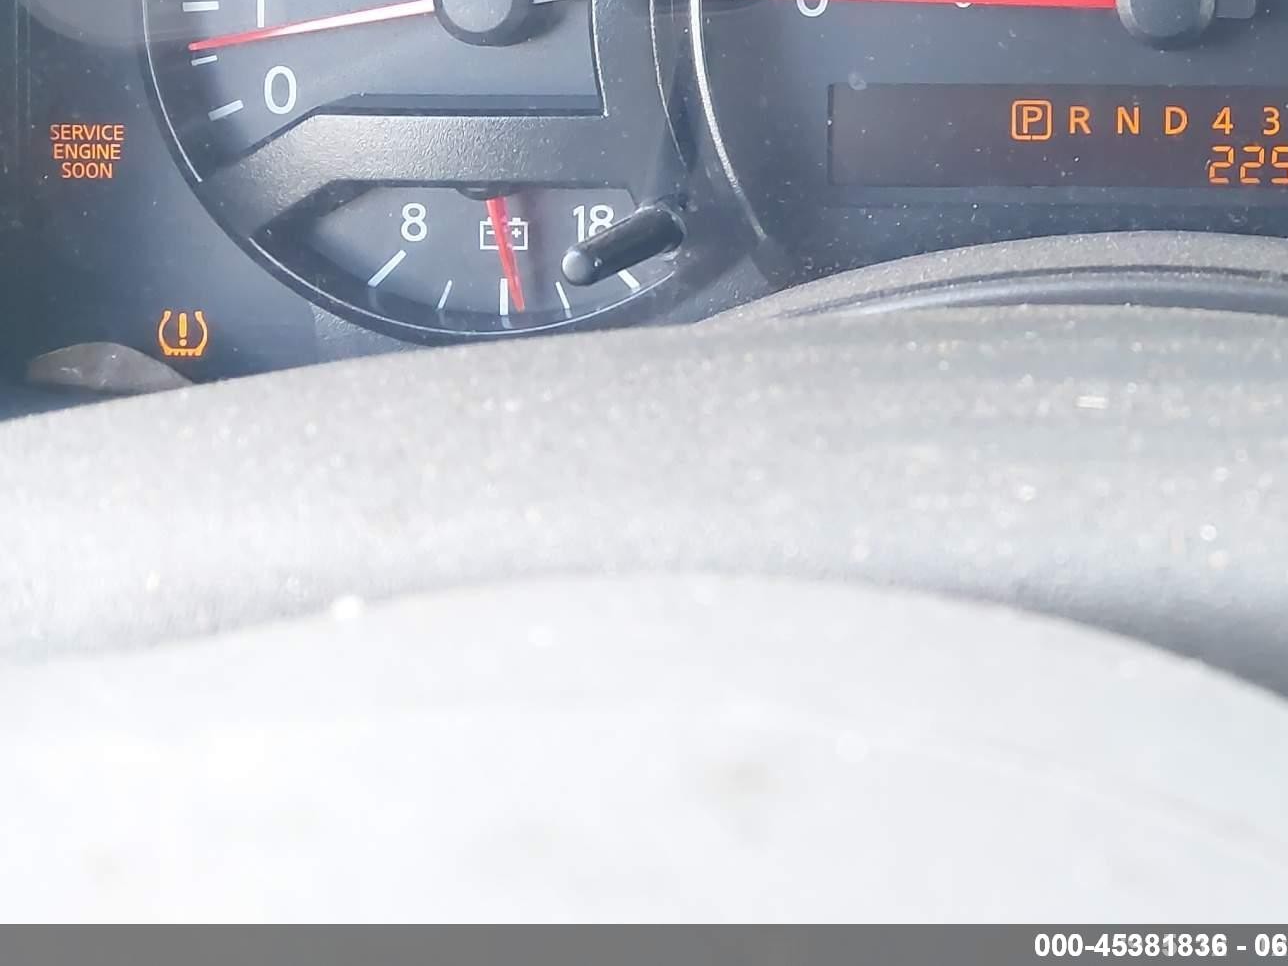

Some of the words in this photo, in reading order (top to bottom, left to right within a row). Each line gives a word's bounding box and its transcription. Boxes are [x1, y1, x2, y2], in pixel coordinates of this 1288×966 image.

[264, 65, 297, 115] 0
[51, 124, 124, 141] SERVICE
[1024, 107, 1042, 133] P
[1069, 106, 1091, 134] R
[1117, 106, 1140, 134] N
[1165, 106, 1188, 135] D
[1212, 106, 1234, 135] 4
[1263, 106, 1280, 136] 3
[53, 143, 121, 160] ENGINE
[62, 162, 113, 179] SOON
[400, 202, 428, 242] 8
[573, 204, 614, 243] 18
